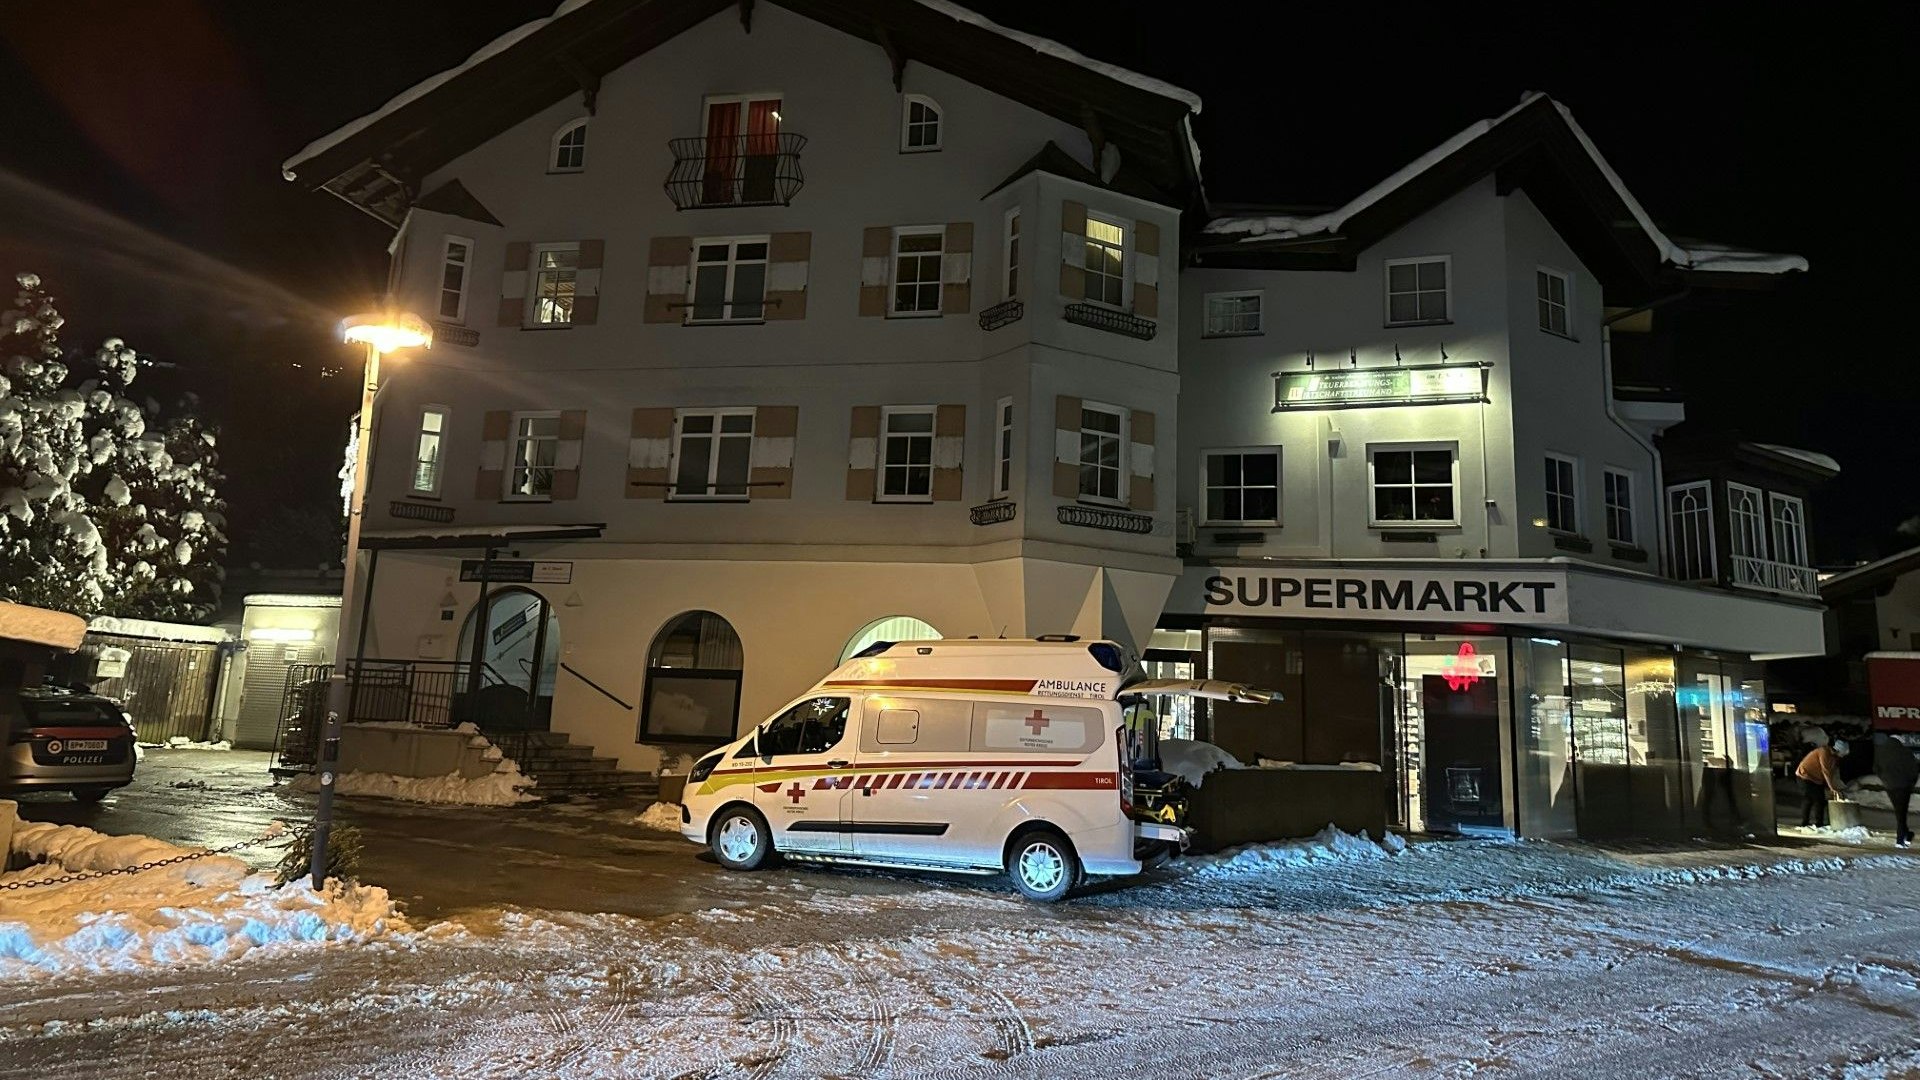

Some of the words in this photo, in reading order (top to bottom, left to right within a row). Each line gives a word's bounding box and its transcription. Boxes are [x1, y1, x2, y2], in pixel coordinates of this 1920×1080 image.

[1203, 575, 1555, 613] SUPERMARKT
[1038, 679, 1106, 692] AMBULANCE
[63, 756, 104, 764] POLIZEI
